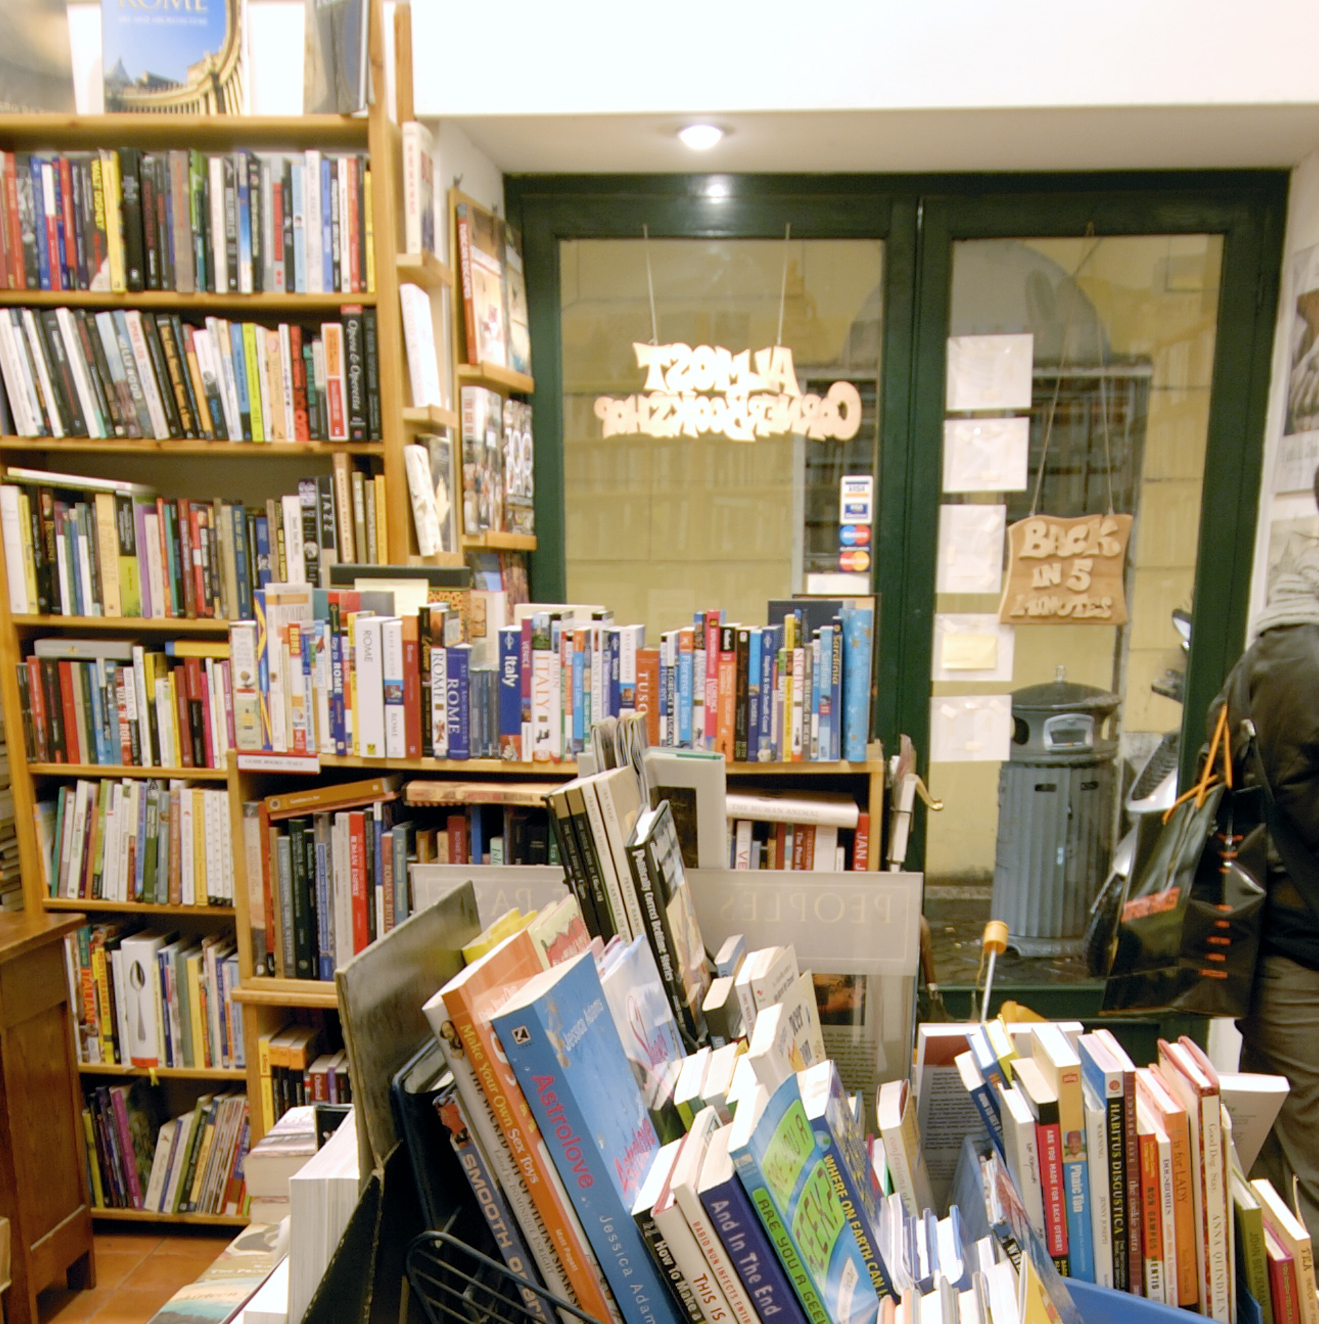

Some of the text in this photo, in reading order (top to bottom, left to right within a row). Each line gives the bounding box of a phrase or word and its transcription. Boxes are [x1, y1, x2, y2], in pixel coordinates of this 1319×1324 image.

[347, 319, 360, 352] Opera
[1018, 520, 1121, 558] BACK
[1033, 558, 1093, 592] IN 5
[1010, 594, 1112, 618] MINUTES
[362, 629, 373, 663] ROME
[502, 655, 516, 688] Italy
[831, 634, 840, 686] Sardinia
[333, 662, 343, 694] ROME
[432, 652, 445, 703] ROME
[535, 654, 551, 710] ITALY
[447, 678, 460, 734] ROME
[461, 1023, 539, 1184] Make Your Own Sex Toys
[532, 1074, 595, 1190] Astrolove
[1109, 1103, 1125, 1236] HABITUS DISGUSTICA
[462, 1153, 513, 1249] SMOOTH
[711, 1199, 783, 1316] And In The End
[758, 1198, 781, 1230] ARE
[776, 1236, 799, 1270] YOU
[795, 1274, 807, 1287] A
